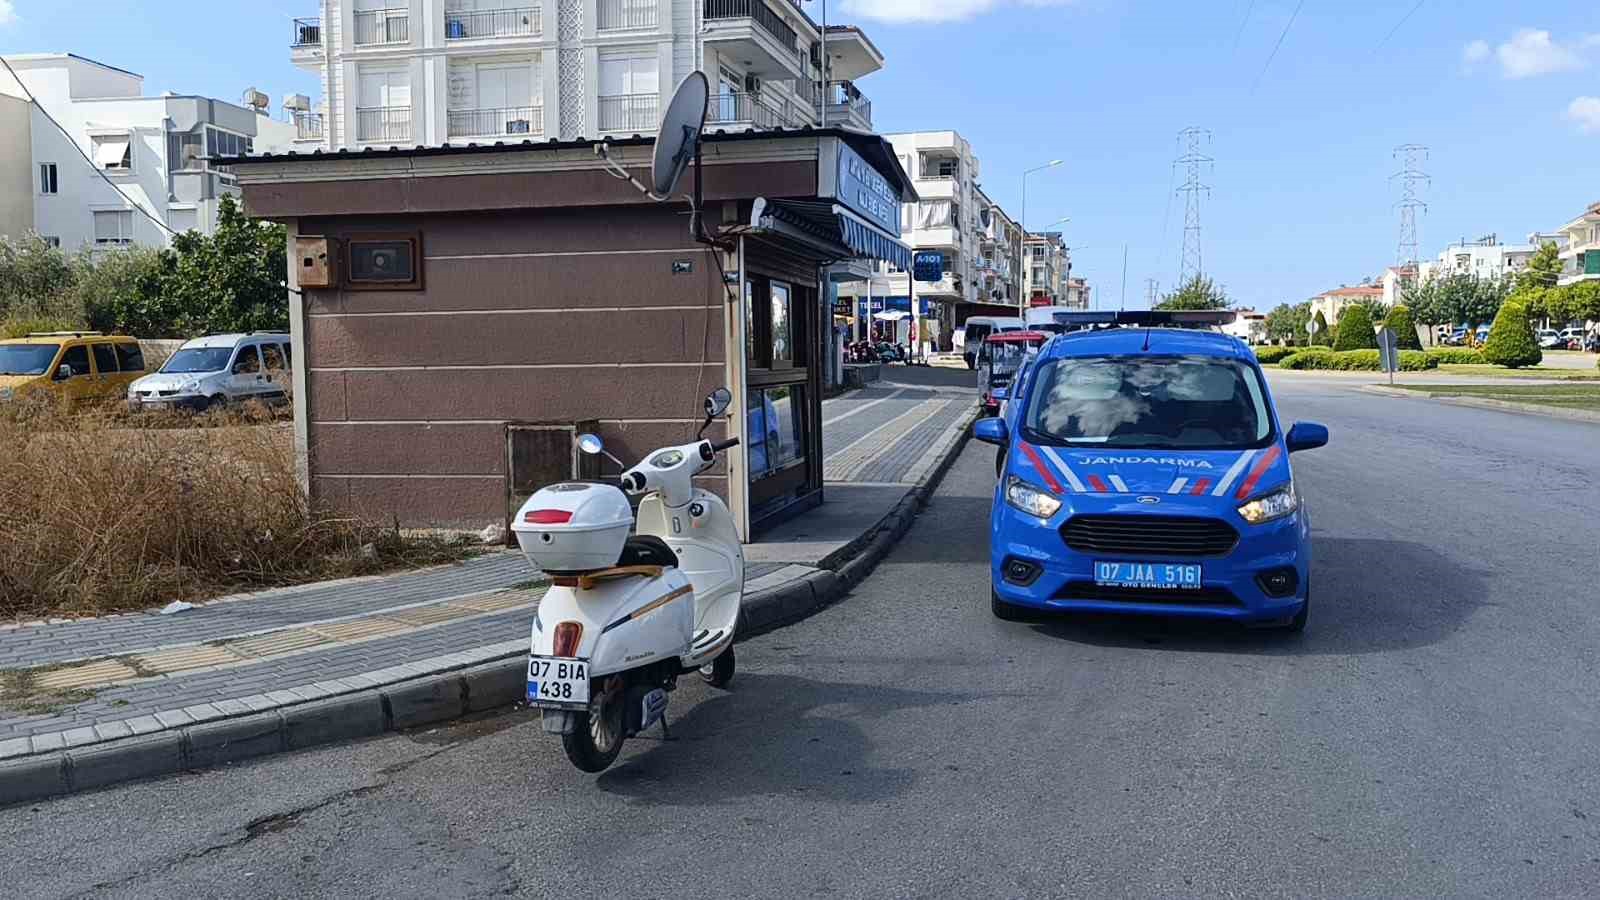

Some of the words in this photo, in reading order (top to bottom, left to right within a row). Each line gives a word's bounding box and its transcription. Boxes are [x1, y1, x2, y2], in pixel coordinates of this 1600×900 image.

[916, 255, 940, 264] A101
[1079, 456, 1213, 469] JANDARMA
[1101, 563, 1119, 580] 07
[1126, 564, 1154, 581] JAA
[1165, 565, 1195, 583] 516
[530, 660, 551, 677] 07
[558, 663, 586, 680] BIA
[540, 681, 572, 698] 438
